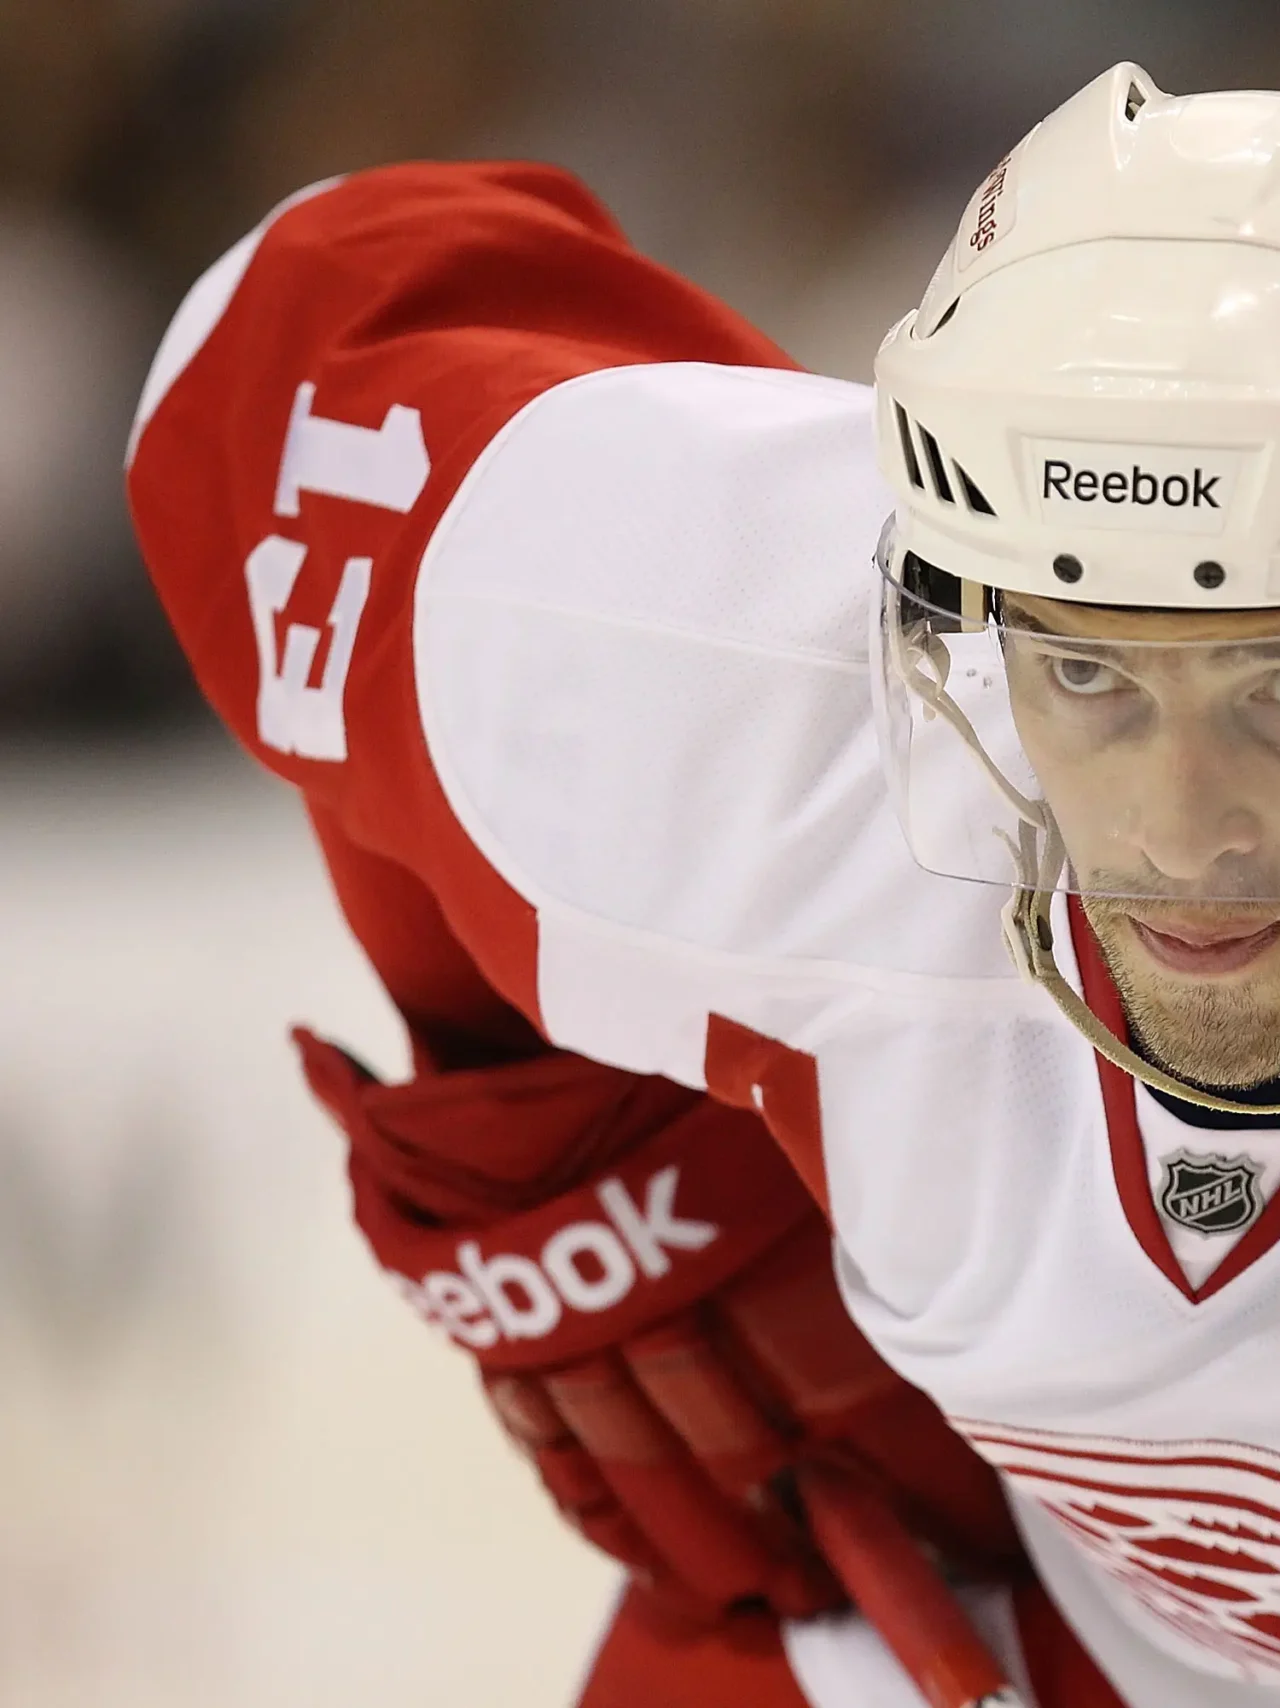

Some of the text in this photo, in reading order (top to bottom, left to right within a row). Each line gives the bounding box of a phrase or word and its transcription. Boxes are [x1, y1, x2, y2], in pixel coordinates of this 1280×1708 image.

[1043, 459, 1222, 508] Reebok
[245, 378, 431, 763] 13
[1180, 1180, 1241, 1218] NHL
